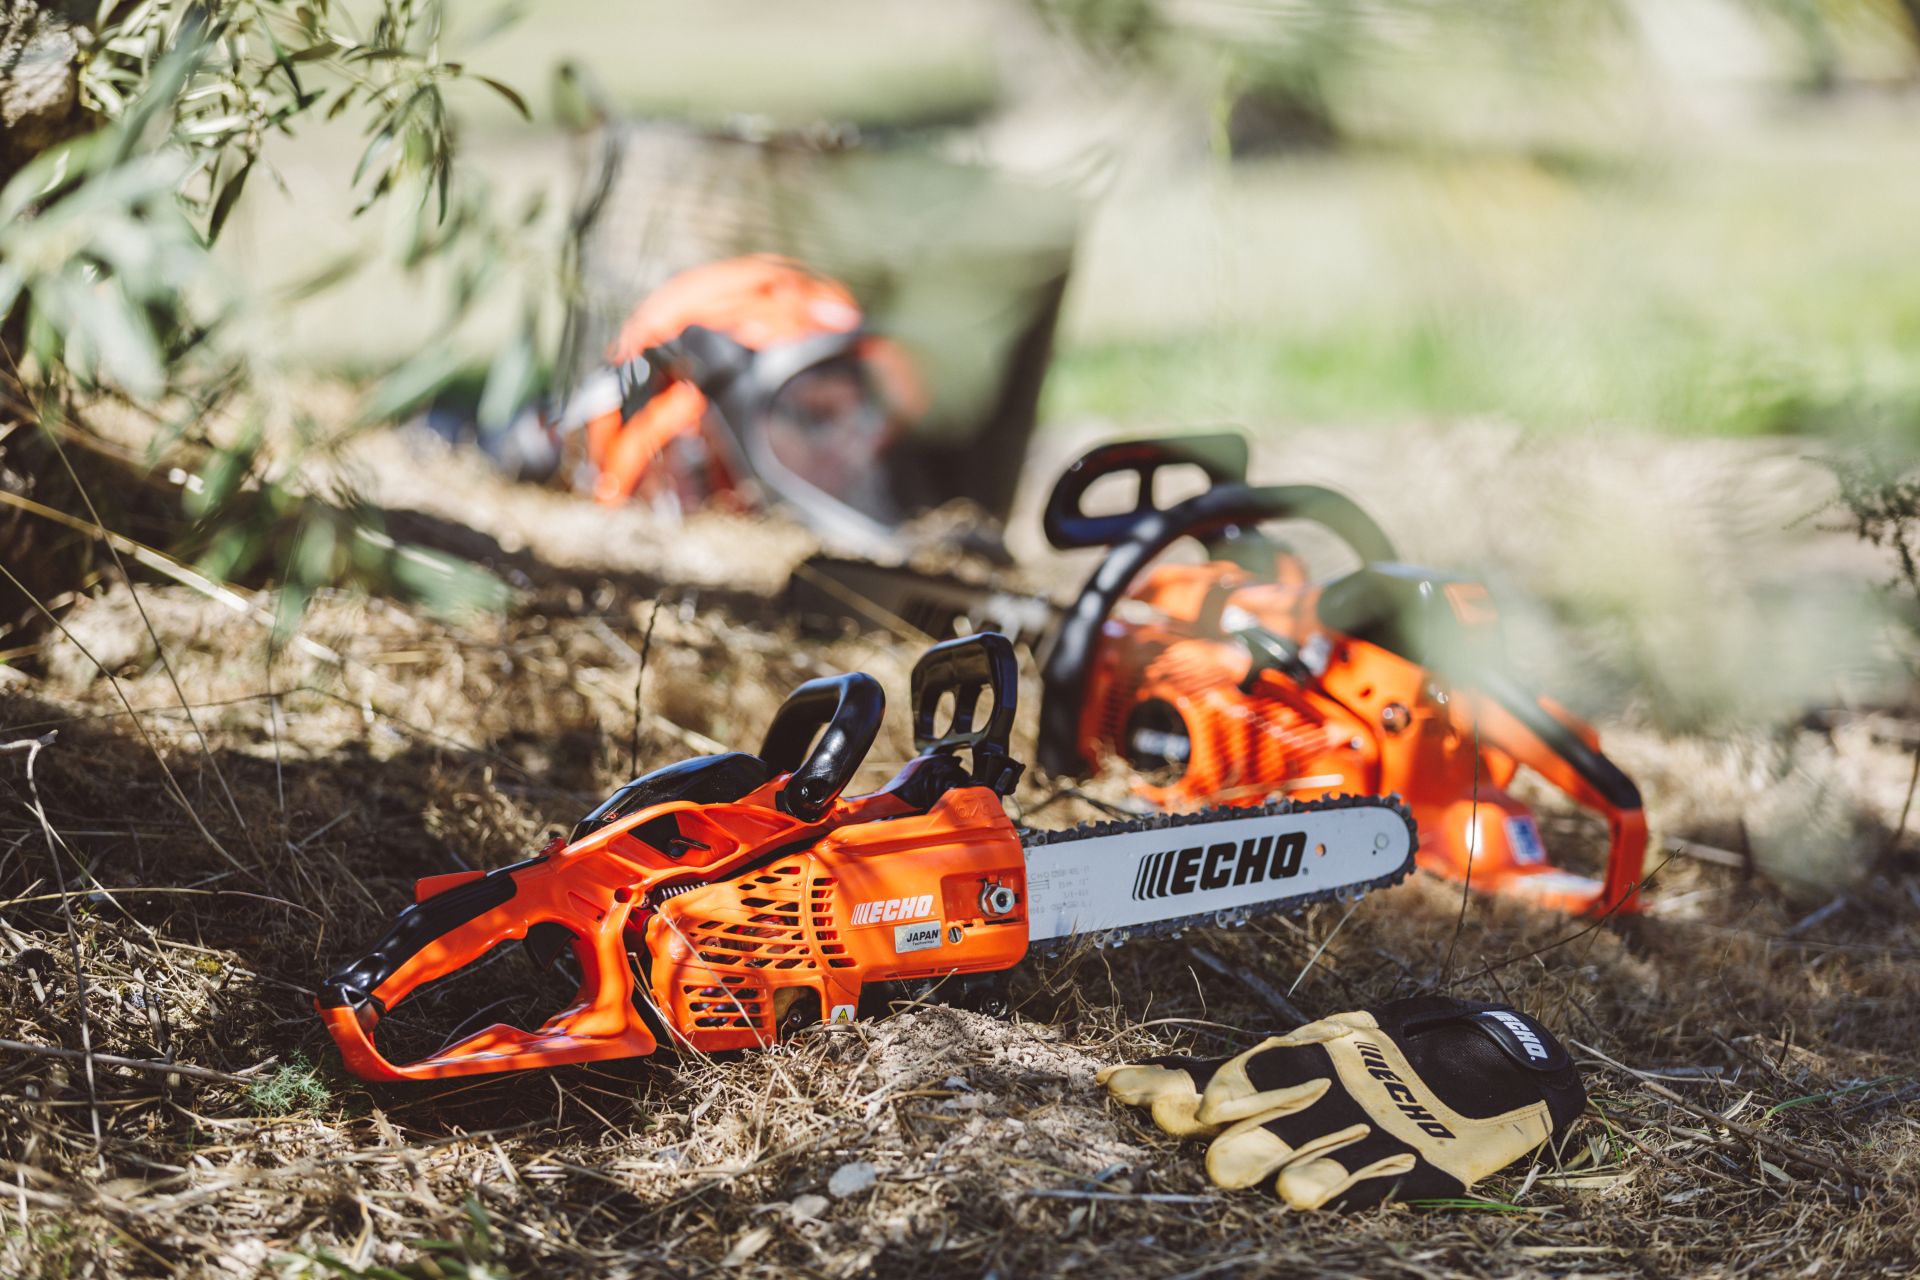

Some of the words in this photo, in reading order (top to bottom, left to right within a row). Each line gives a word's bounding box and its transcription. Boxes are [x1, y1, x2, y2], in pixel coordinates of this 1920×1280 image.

[1169, 831, 1307, 896] ECHO
[867, 894, 934, 923] ECHO
[906, 929, 939, 943] JAPAN
[1494, 1014, 1549, 1060] ECHO
[1366, 1067, 1457, 1140] ECHO
